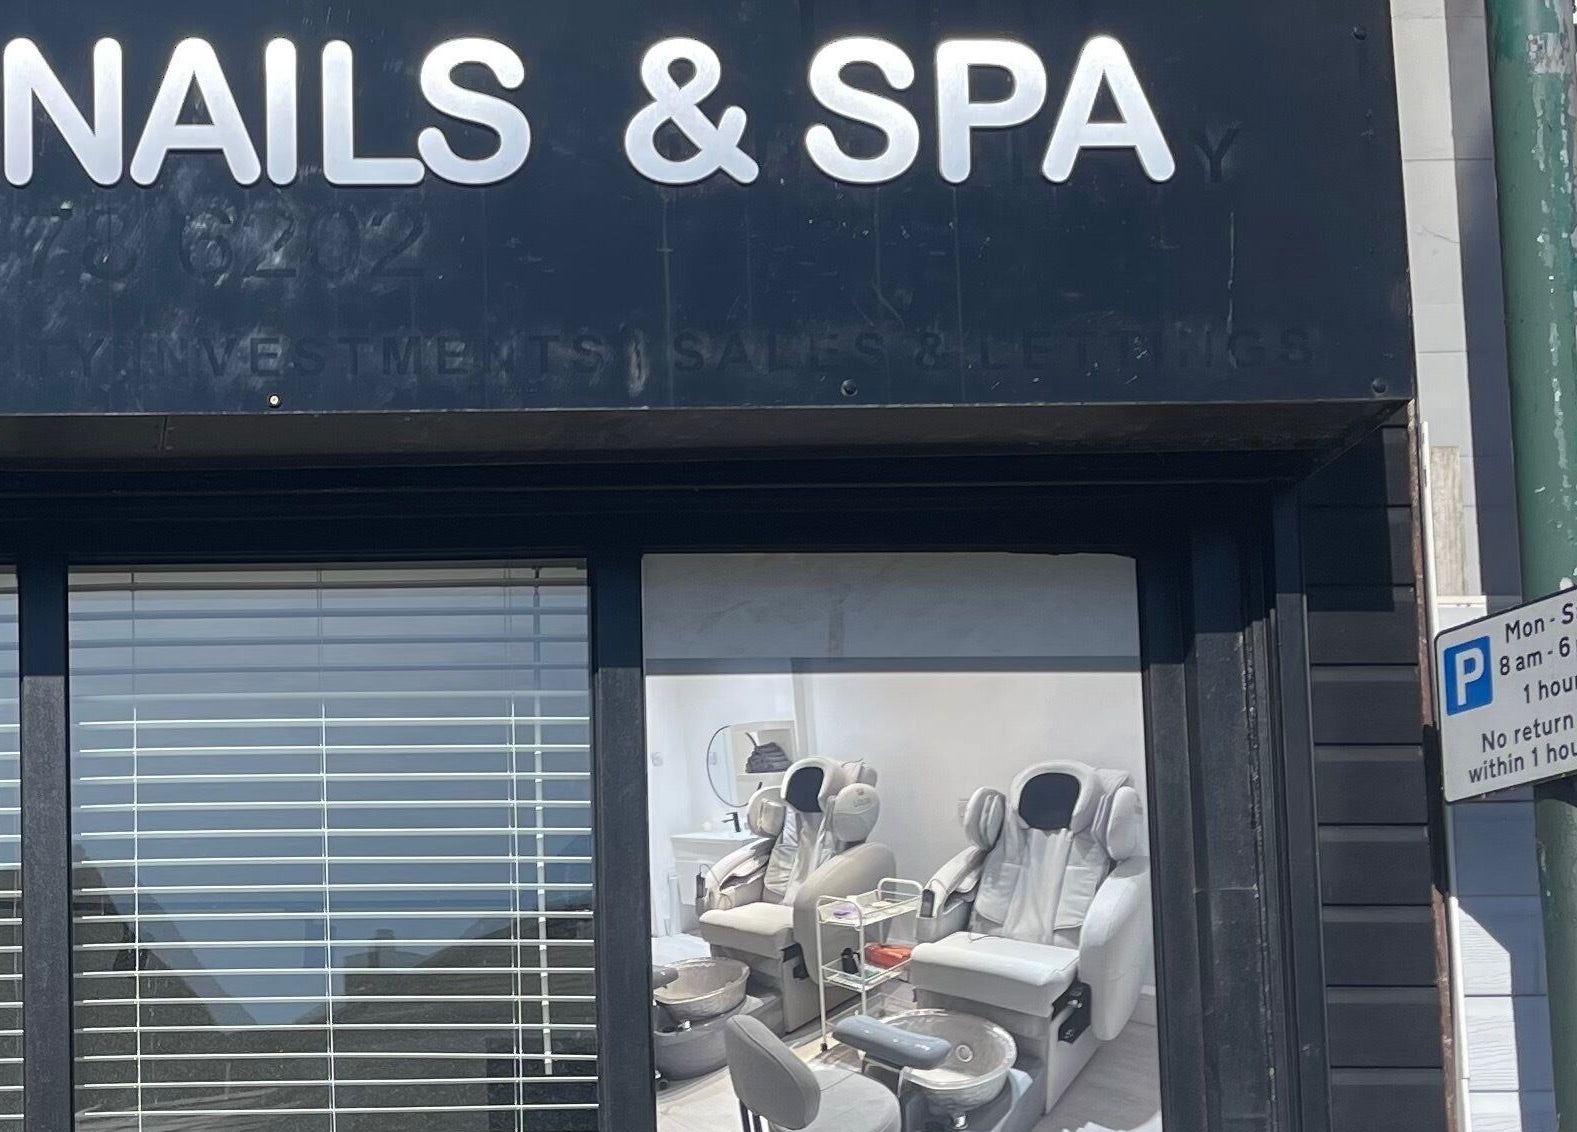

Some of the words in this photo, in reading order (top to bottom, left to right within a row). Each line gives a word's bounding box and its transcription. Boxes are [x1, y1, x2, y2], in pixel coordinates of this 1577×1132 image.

[2, 36, 531, 186] NAILS
[624, 36, 760, 184] &
[804, 34, 1176, 184] SPA
[1505, 618, 1545, 644] Mon
[1561, 602, 1577, 625] S
[1500, 655, 1510, 676] 8
[1516, 650, 1543, 672] am
[1559, 636, 1571, 658] 6
[1455, 648, 1485, 706] P
[1523, 683, 1530, 704] 1
[1538, 675, 1577, 701] hou
[1481, 730, 1508, 753] No
[1514, 714, 1574, 745] return
[1468, 752, 1525, 783] within
[1531, 746, 1538, 767] 1
